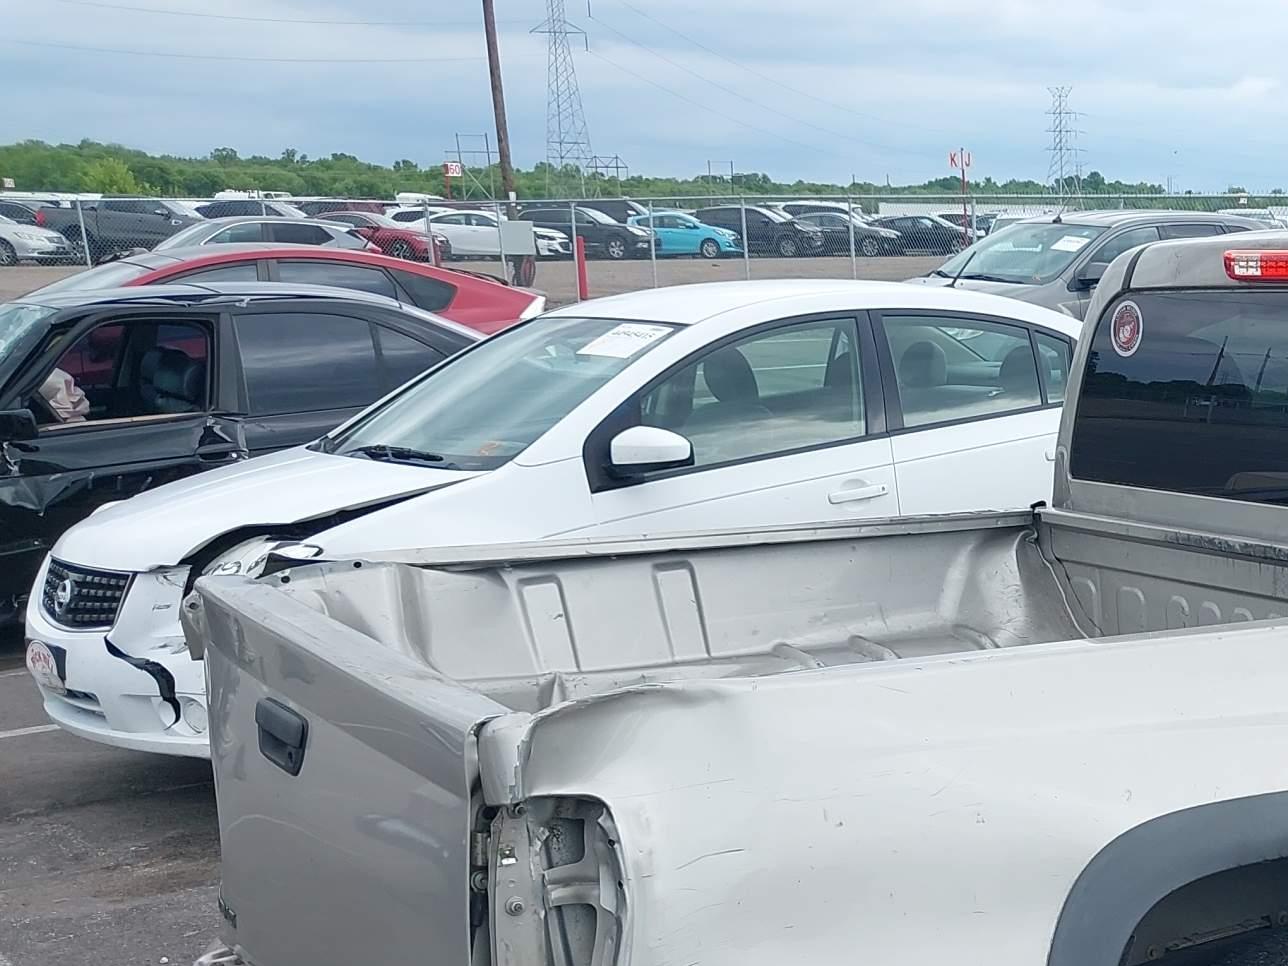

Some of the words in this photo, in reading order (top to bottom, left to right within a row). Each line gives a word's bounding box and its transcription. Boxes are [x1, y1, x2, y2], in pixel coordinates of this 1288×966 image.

[949, 152, 958, 168] K
[964, 152, 971, 168] J
[448, 164, 461, 175] 60
